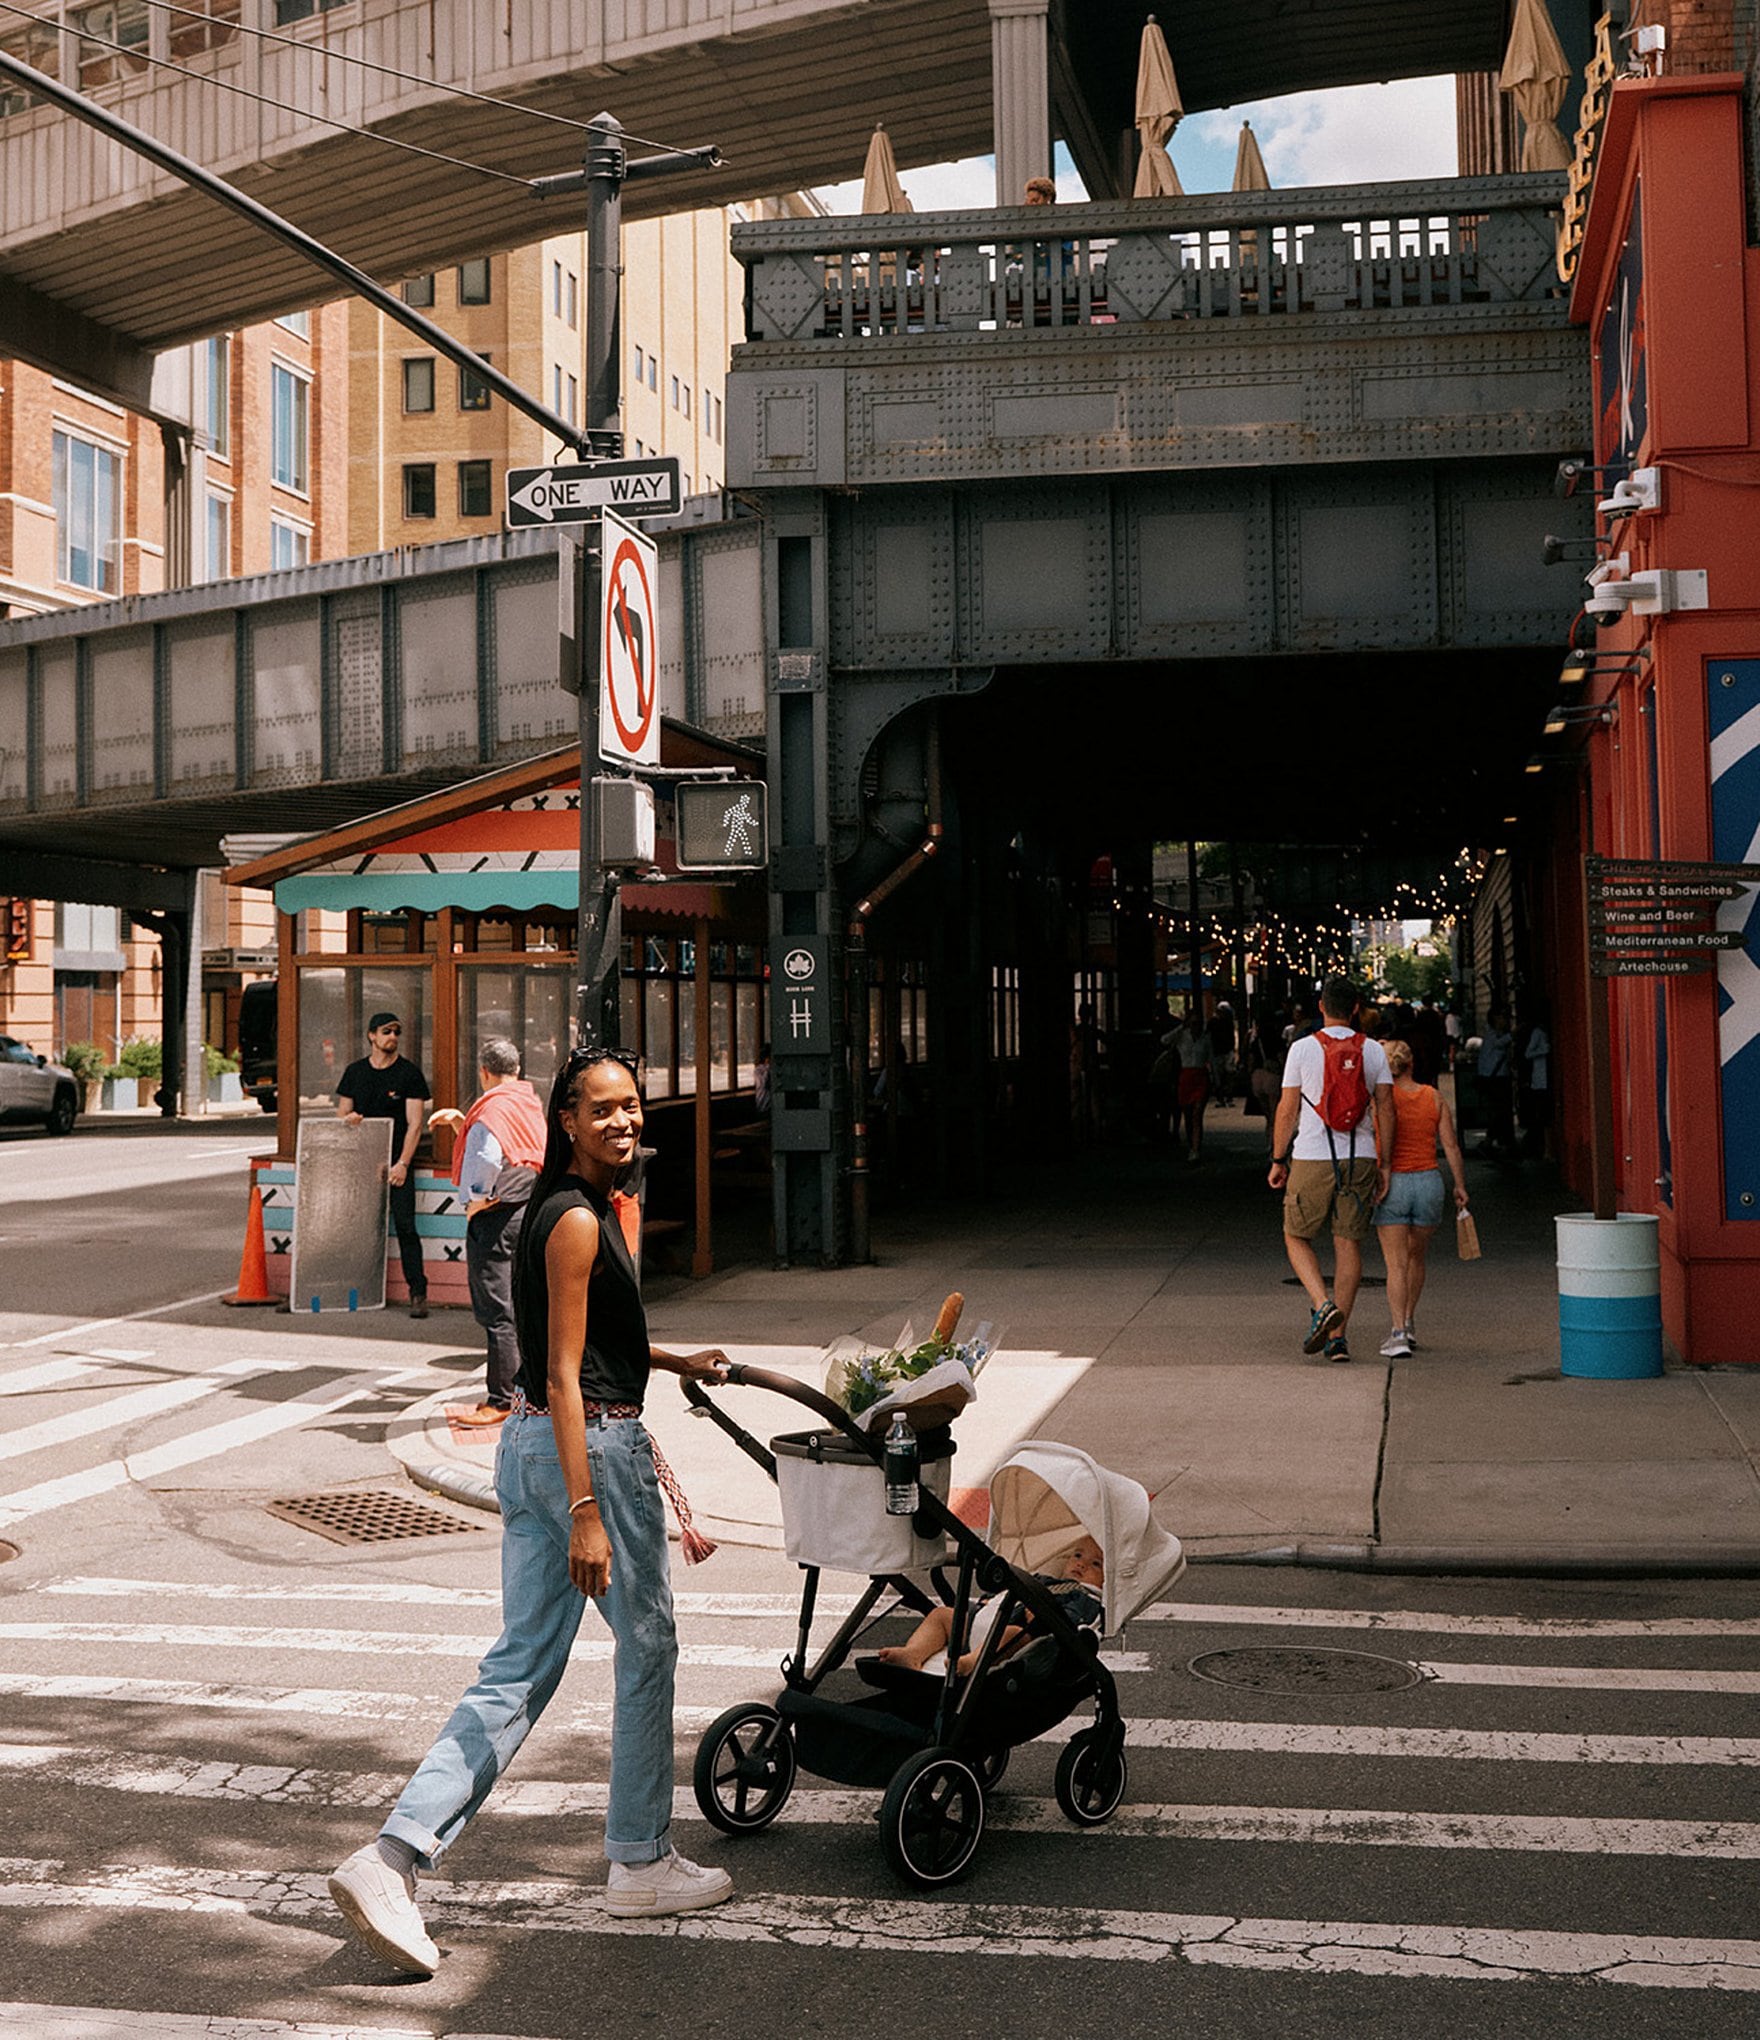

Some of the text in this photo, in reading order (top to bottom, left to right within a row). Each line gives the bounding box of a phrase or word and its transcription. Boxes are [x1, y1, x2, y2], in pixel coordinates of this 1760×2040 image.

[531, 475, 664, 508] ONE WAY
[1601, 885, 1733, 897] Steaks & Sandwiches
[1605, 910, 1695, 922] Wine and Beer
[1605, 935, 1729, 946] Mediterranean Food
[1619, 961, 1689, 972] Artechouse
